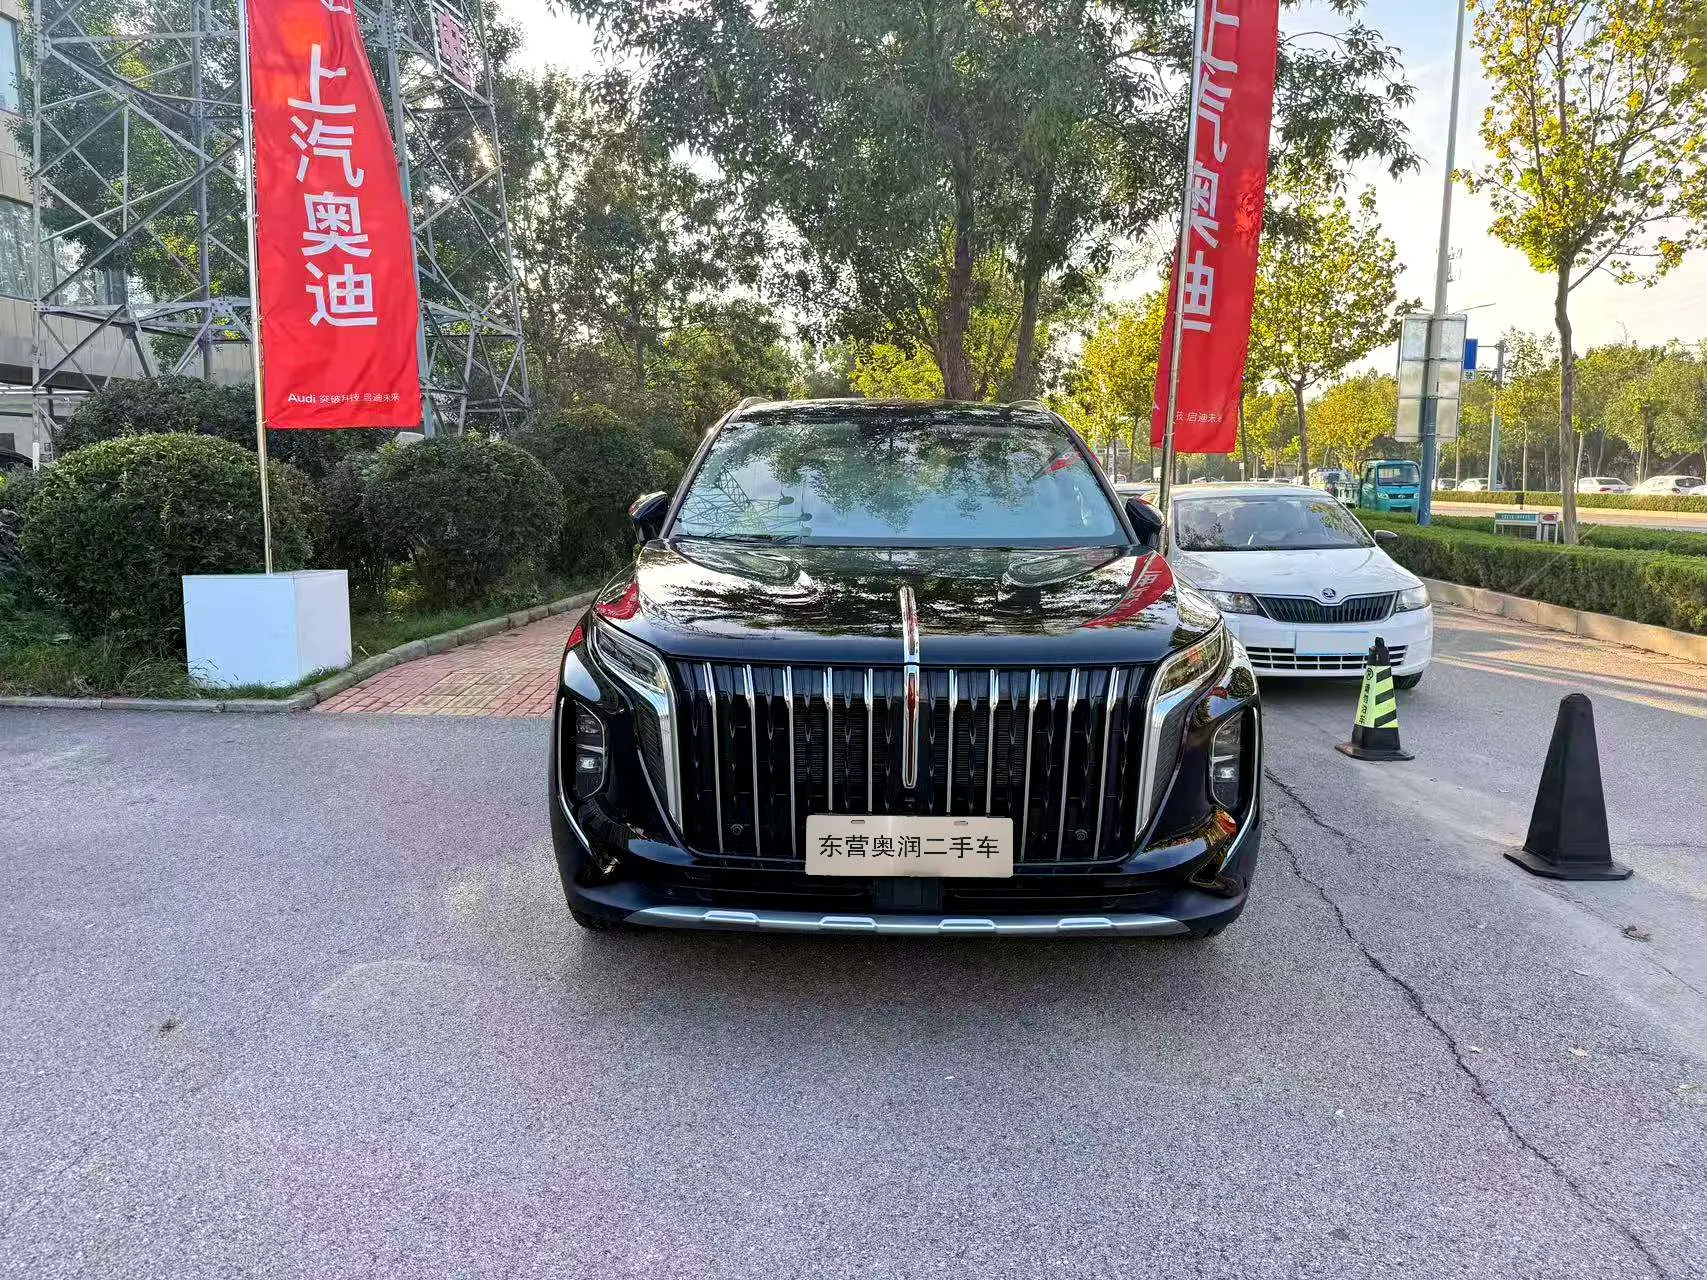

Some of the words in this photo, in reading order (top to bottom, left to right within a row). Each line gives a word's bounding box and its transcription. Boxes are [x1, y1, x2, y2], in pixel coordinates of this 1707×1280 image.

[288, 43, 378, 327] 上汽奥迪
[287, 393, 316, 404] Audi
[818, 834, 1000, 859] 东营奥润二手车
